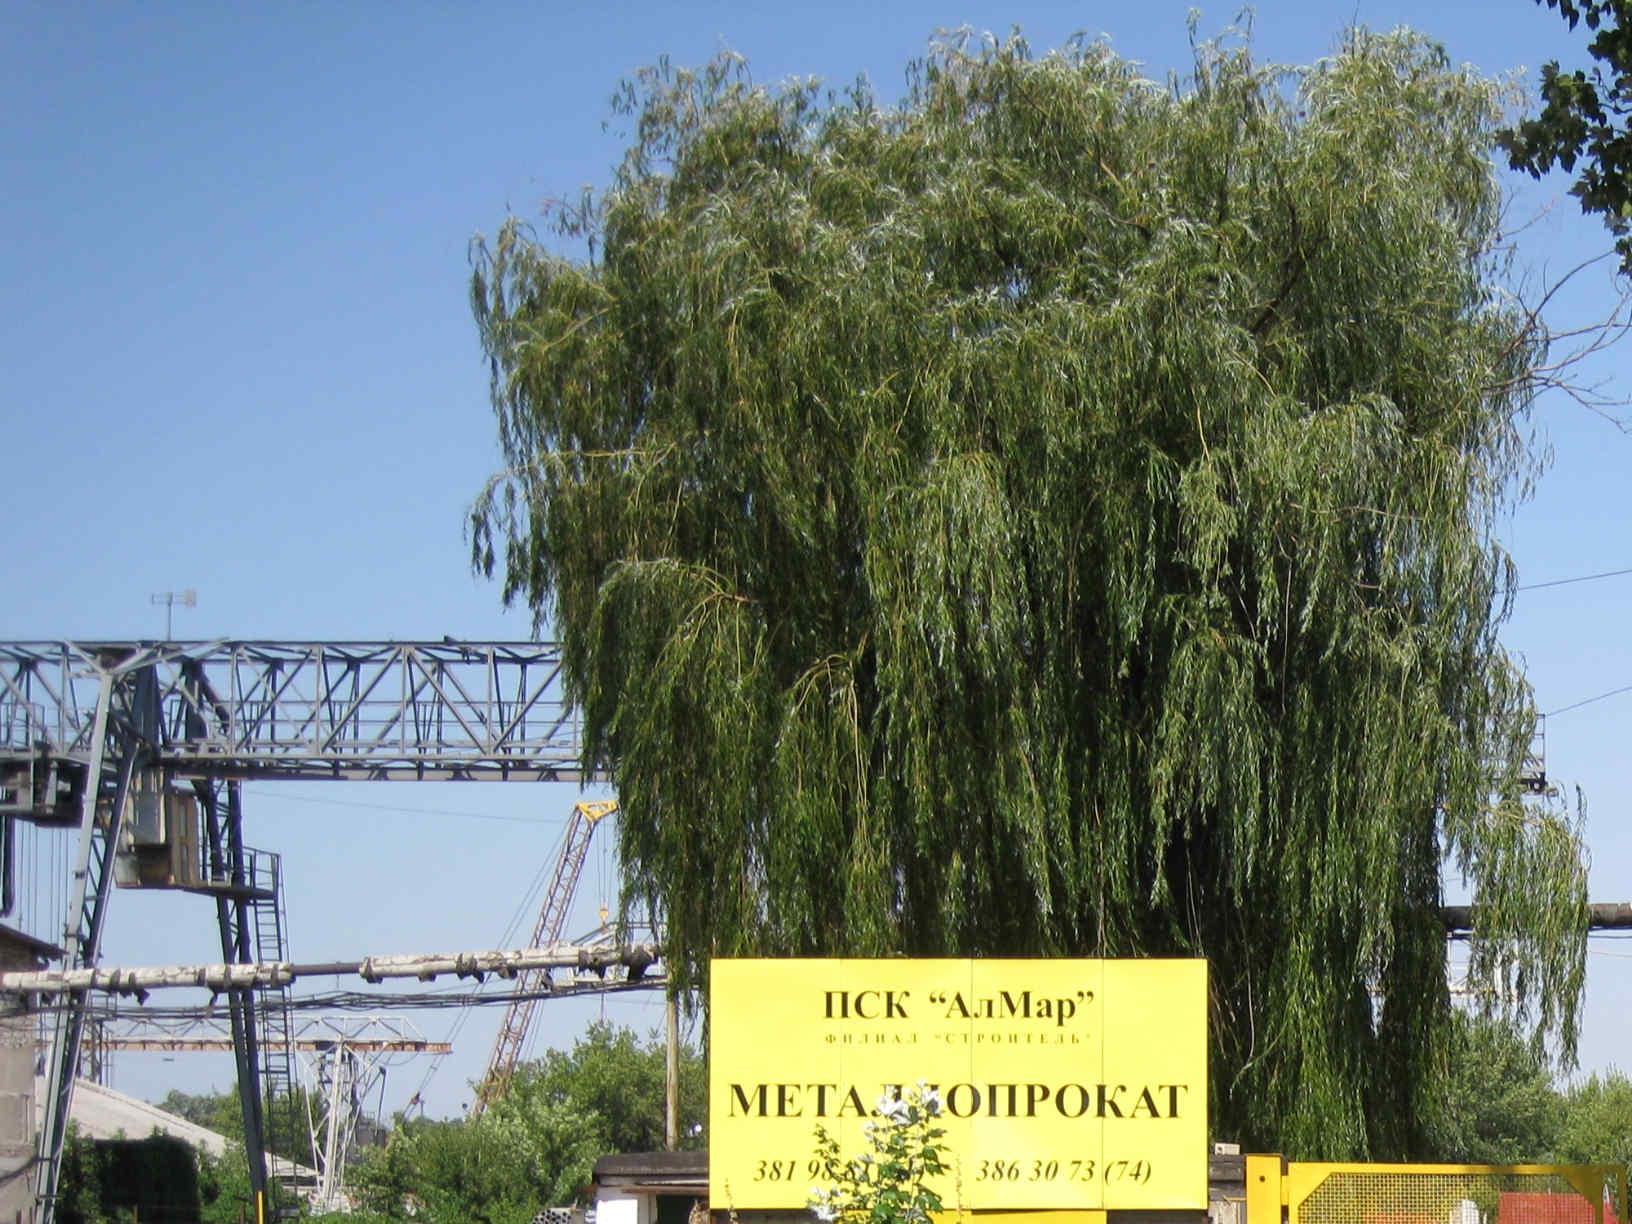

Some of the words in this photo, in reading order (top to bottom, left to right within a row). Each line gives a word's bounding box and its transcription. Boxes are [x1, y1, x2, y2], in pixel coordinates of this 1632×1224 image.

[824, 990, 911, 1020] ПСК
[825, 1032, 918, 1045] ФИЛИАЛ
[753, 1159, 796, 1182] 381
[976, 1159, 1020, 1182] 386
[1029, 1159, 1059, 1182] 30
[1069, 1159, 1097, 1182] 73
[1104, 1159, 1152, 1185] (74)
